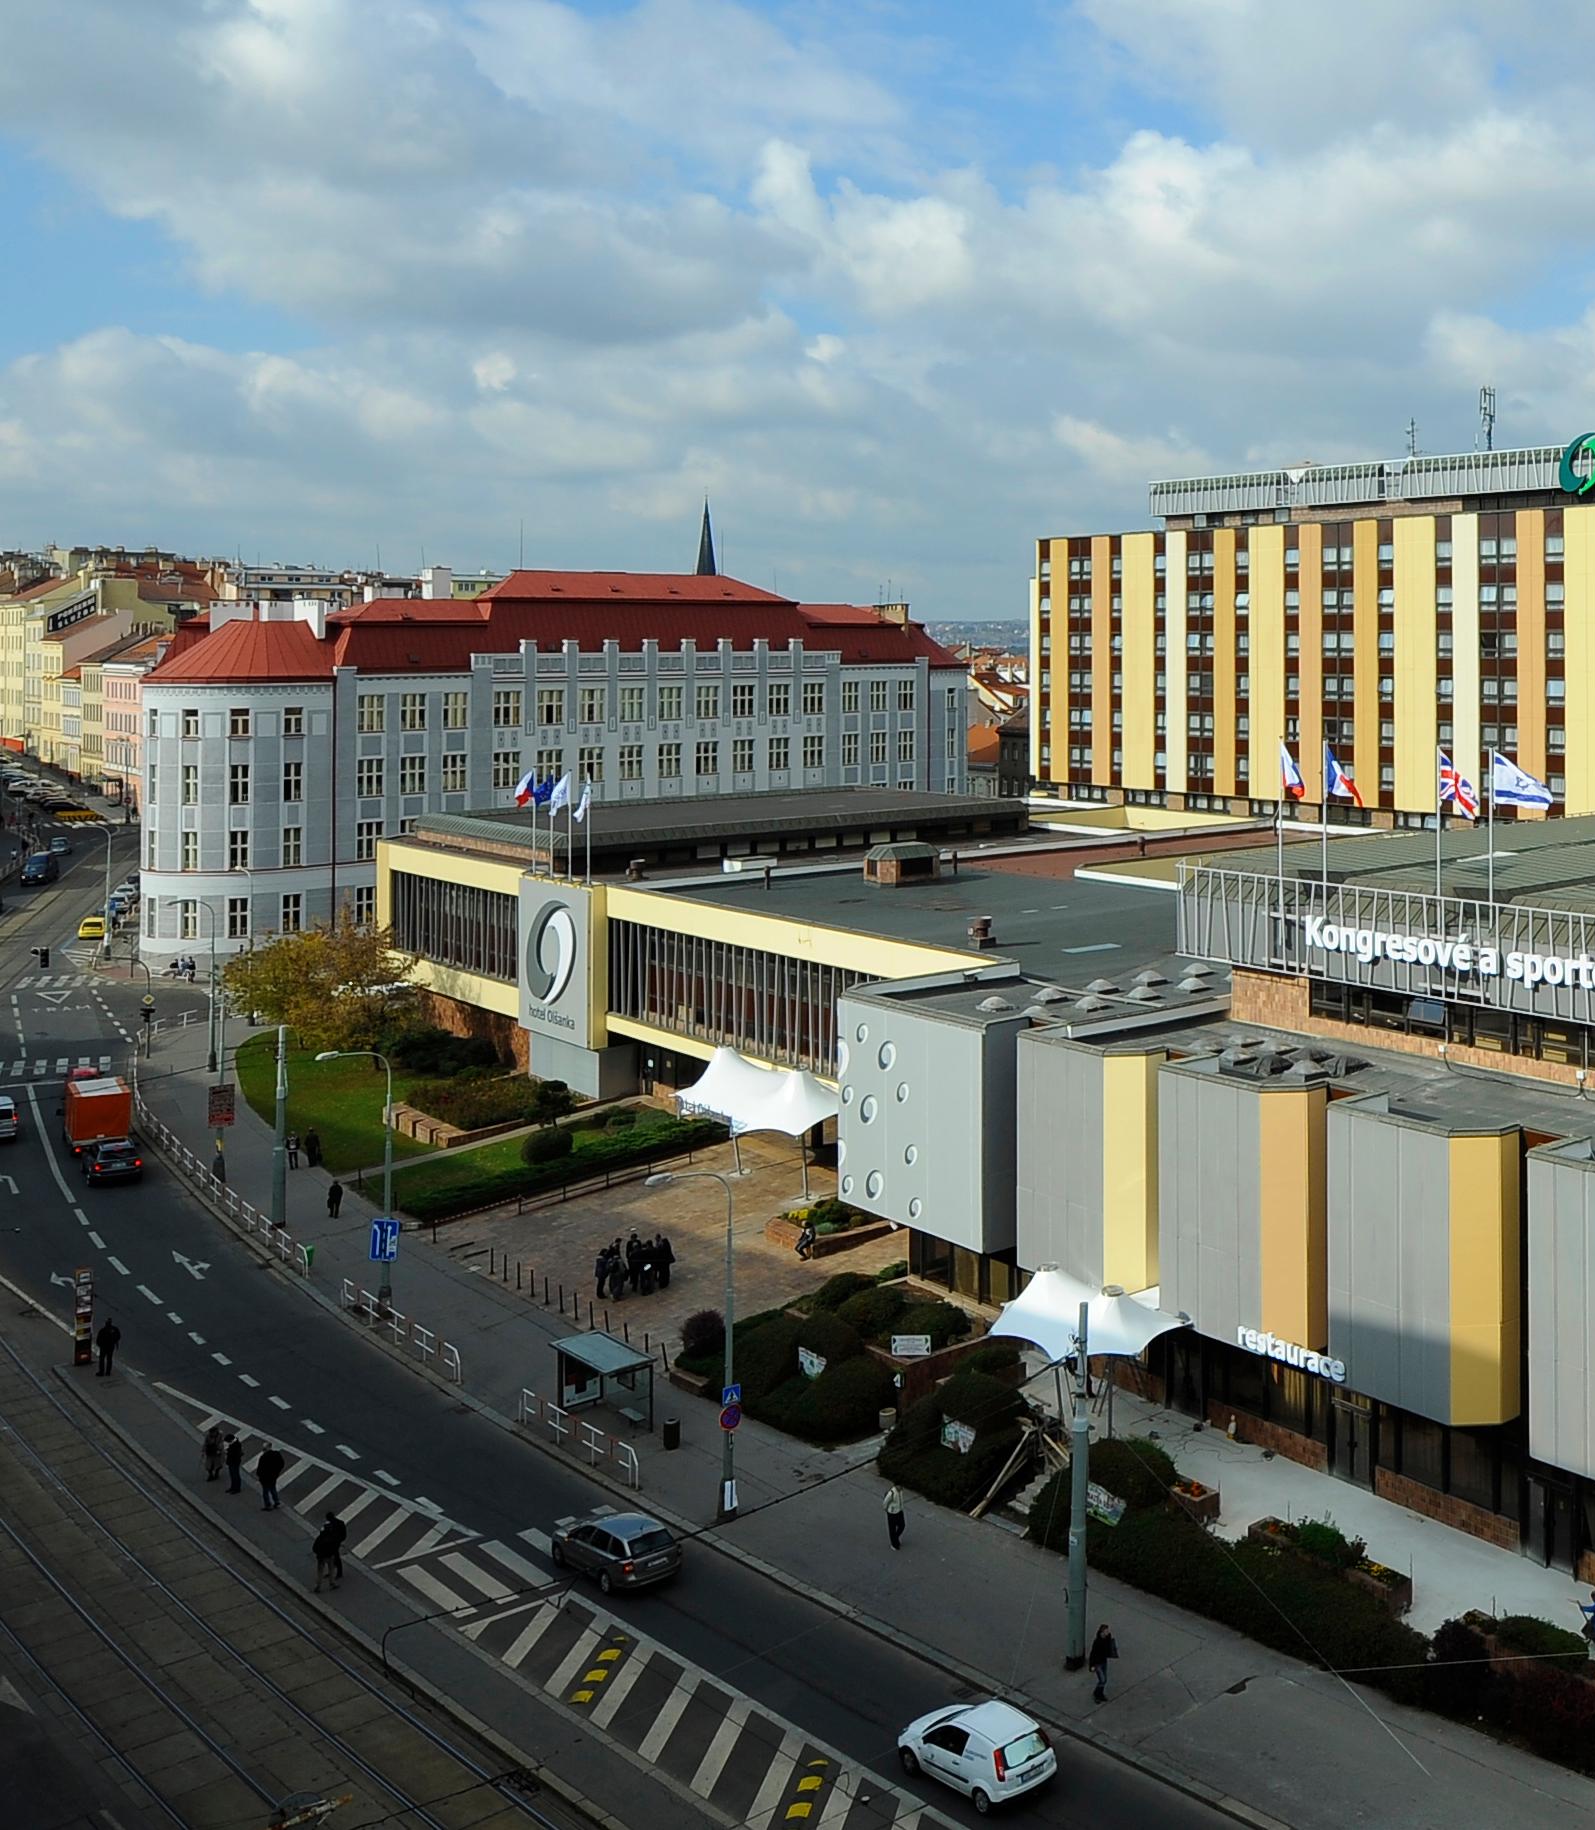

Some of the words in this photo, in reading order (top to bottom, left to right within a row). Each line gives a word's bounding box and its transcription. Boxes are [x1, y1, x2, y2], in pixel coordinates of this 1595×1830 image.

[1305, 915, 1472, 970] Kongresové
[1479, 946, 1499, 976] a
[31, 1004, 92, 1013] TRAM
[528, 1003, 546, 1021] hotel
[547, 1009, 575, 1030] Olšanka
[1237, 1325, 1346, 1382] restaurace
